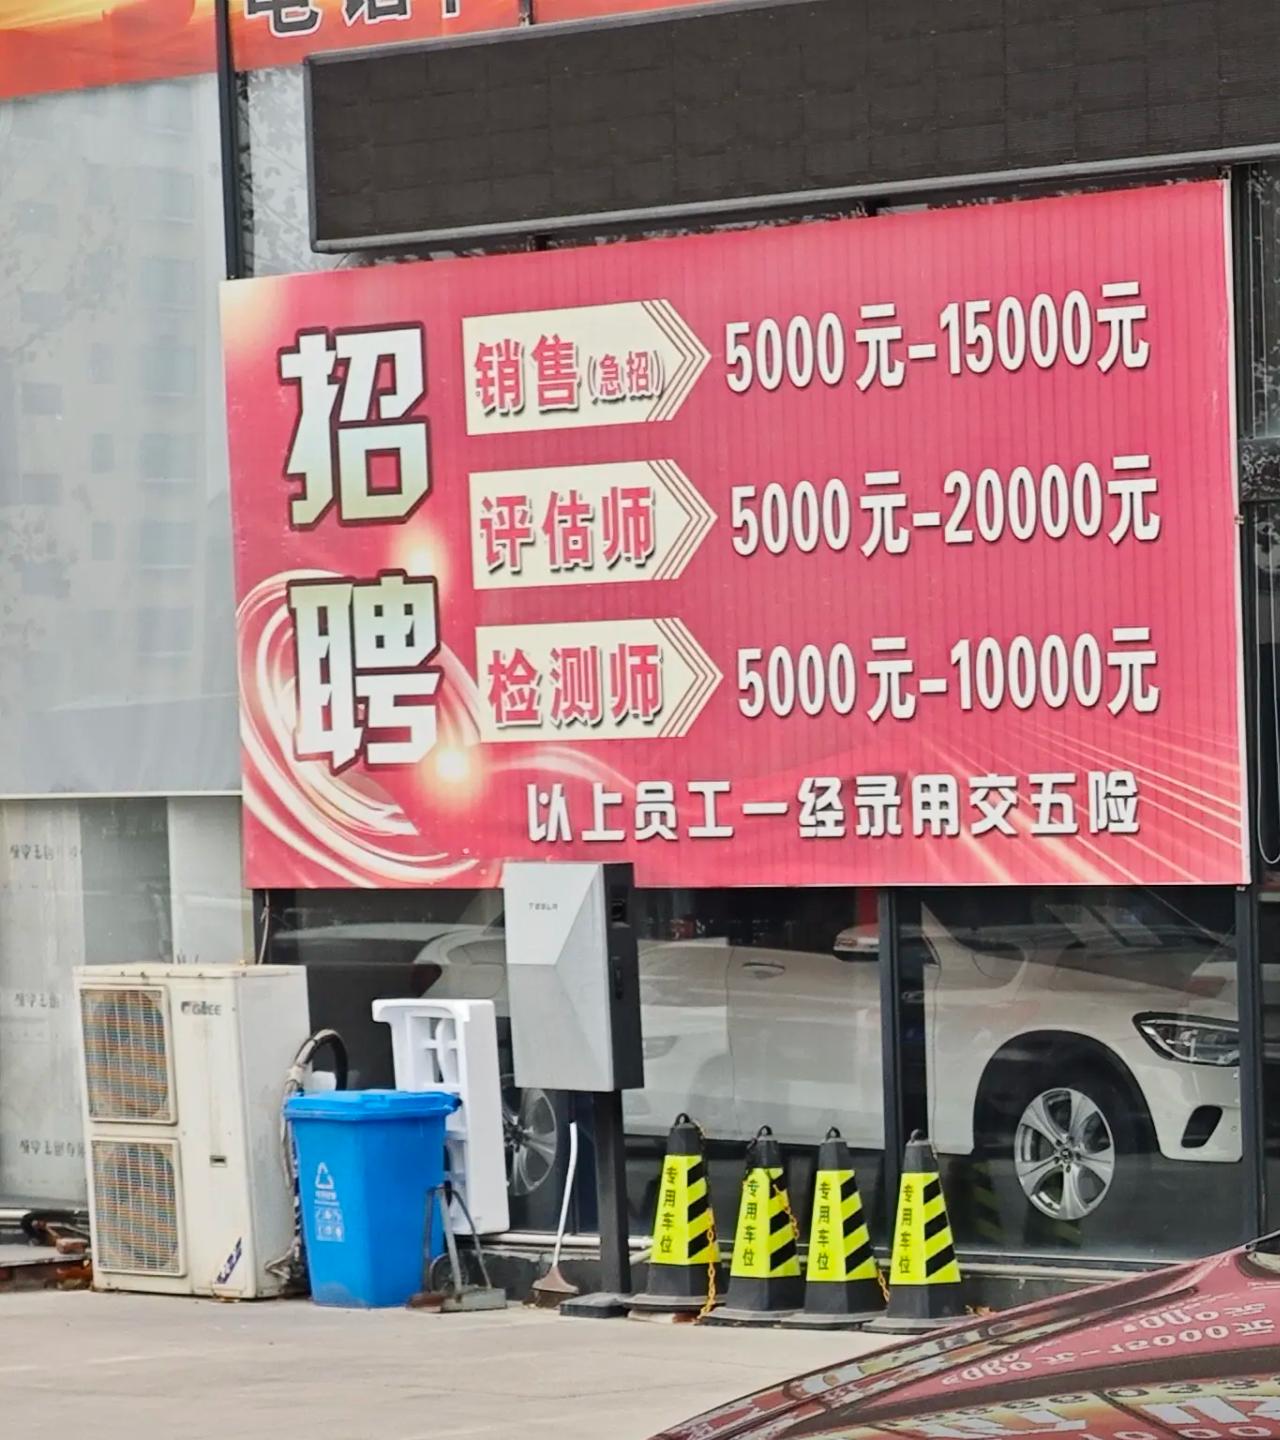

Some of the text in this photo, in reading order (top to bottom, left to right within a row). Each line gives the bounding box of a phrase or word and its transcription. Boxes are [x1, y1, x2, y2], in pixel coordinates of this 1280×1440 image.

[724, 281, 1151, 394] 5000元-15000元
[278, 321, 441, 771] 招聘
[481, 485, 656, 575] 评估师
[731, 454, 1160, 560] 5000元-20000元
[488, 642, 664, 728] 检测师
[736, 627, 1159, 723] 5000元-10000元
[527, 769, 1142, 843] 以上员工一经录用交五险
[660, 1165, 678, 1254] 专用车位
[742, 1178, 760, 1267] 专用车位
[815, 1181, 832, 1271] 专用车位
[898, 1183, 915, 1274] 专用车位
